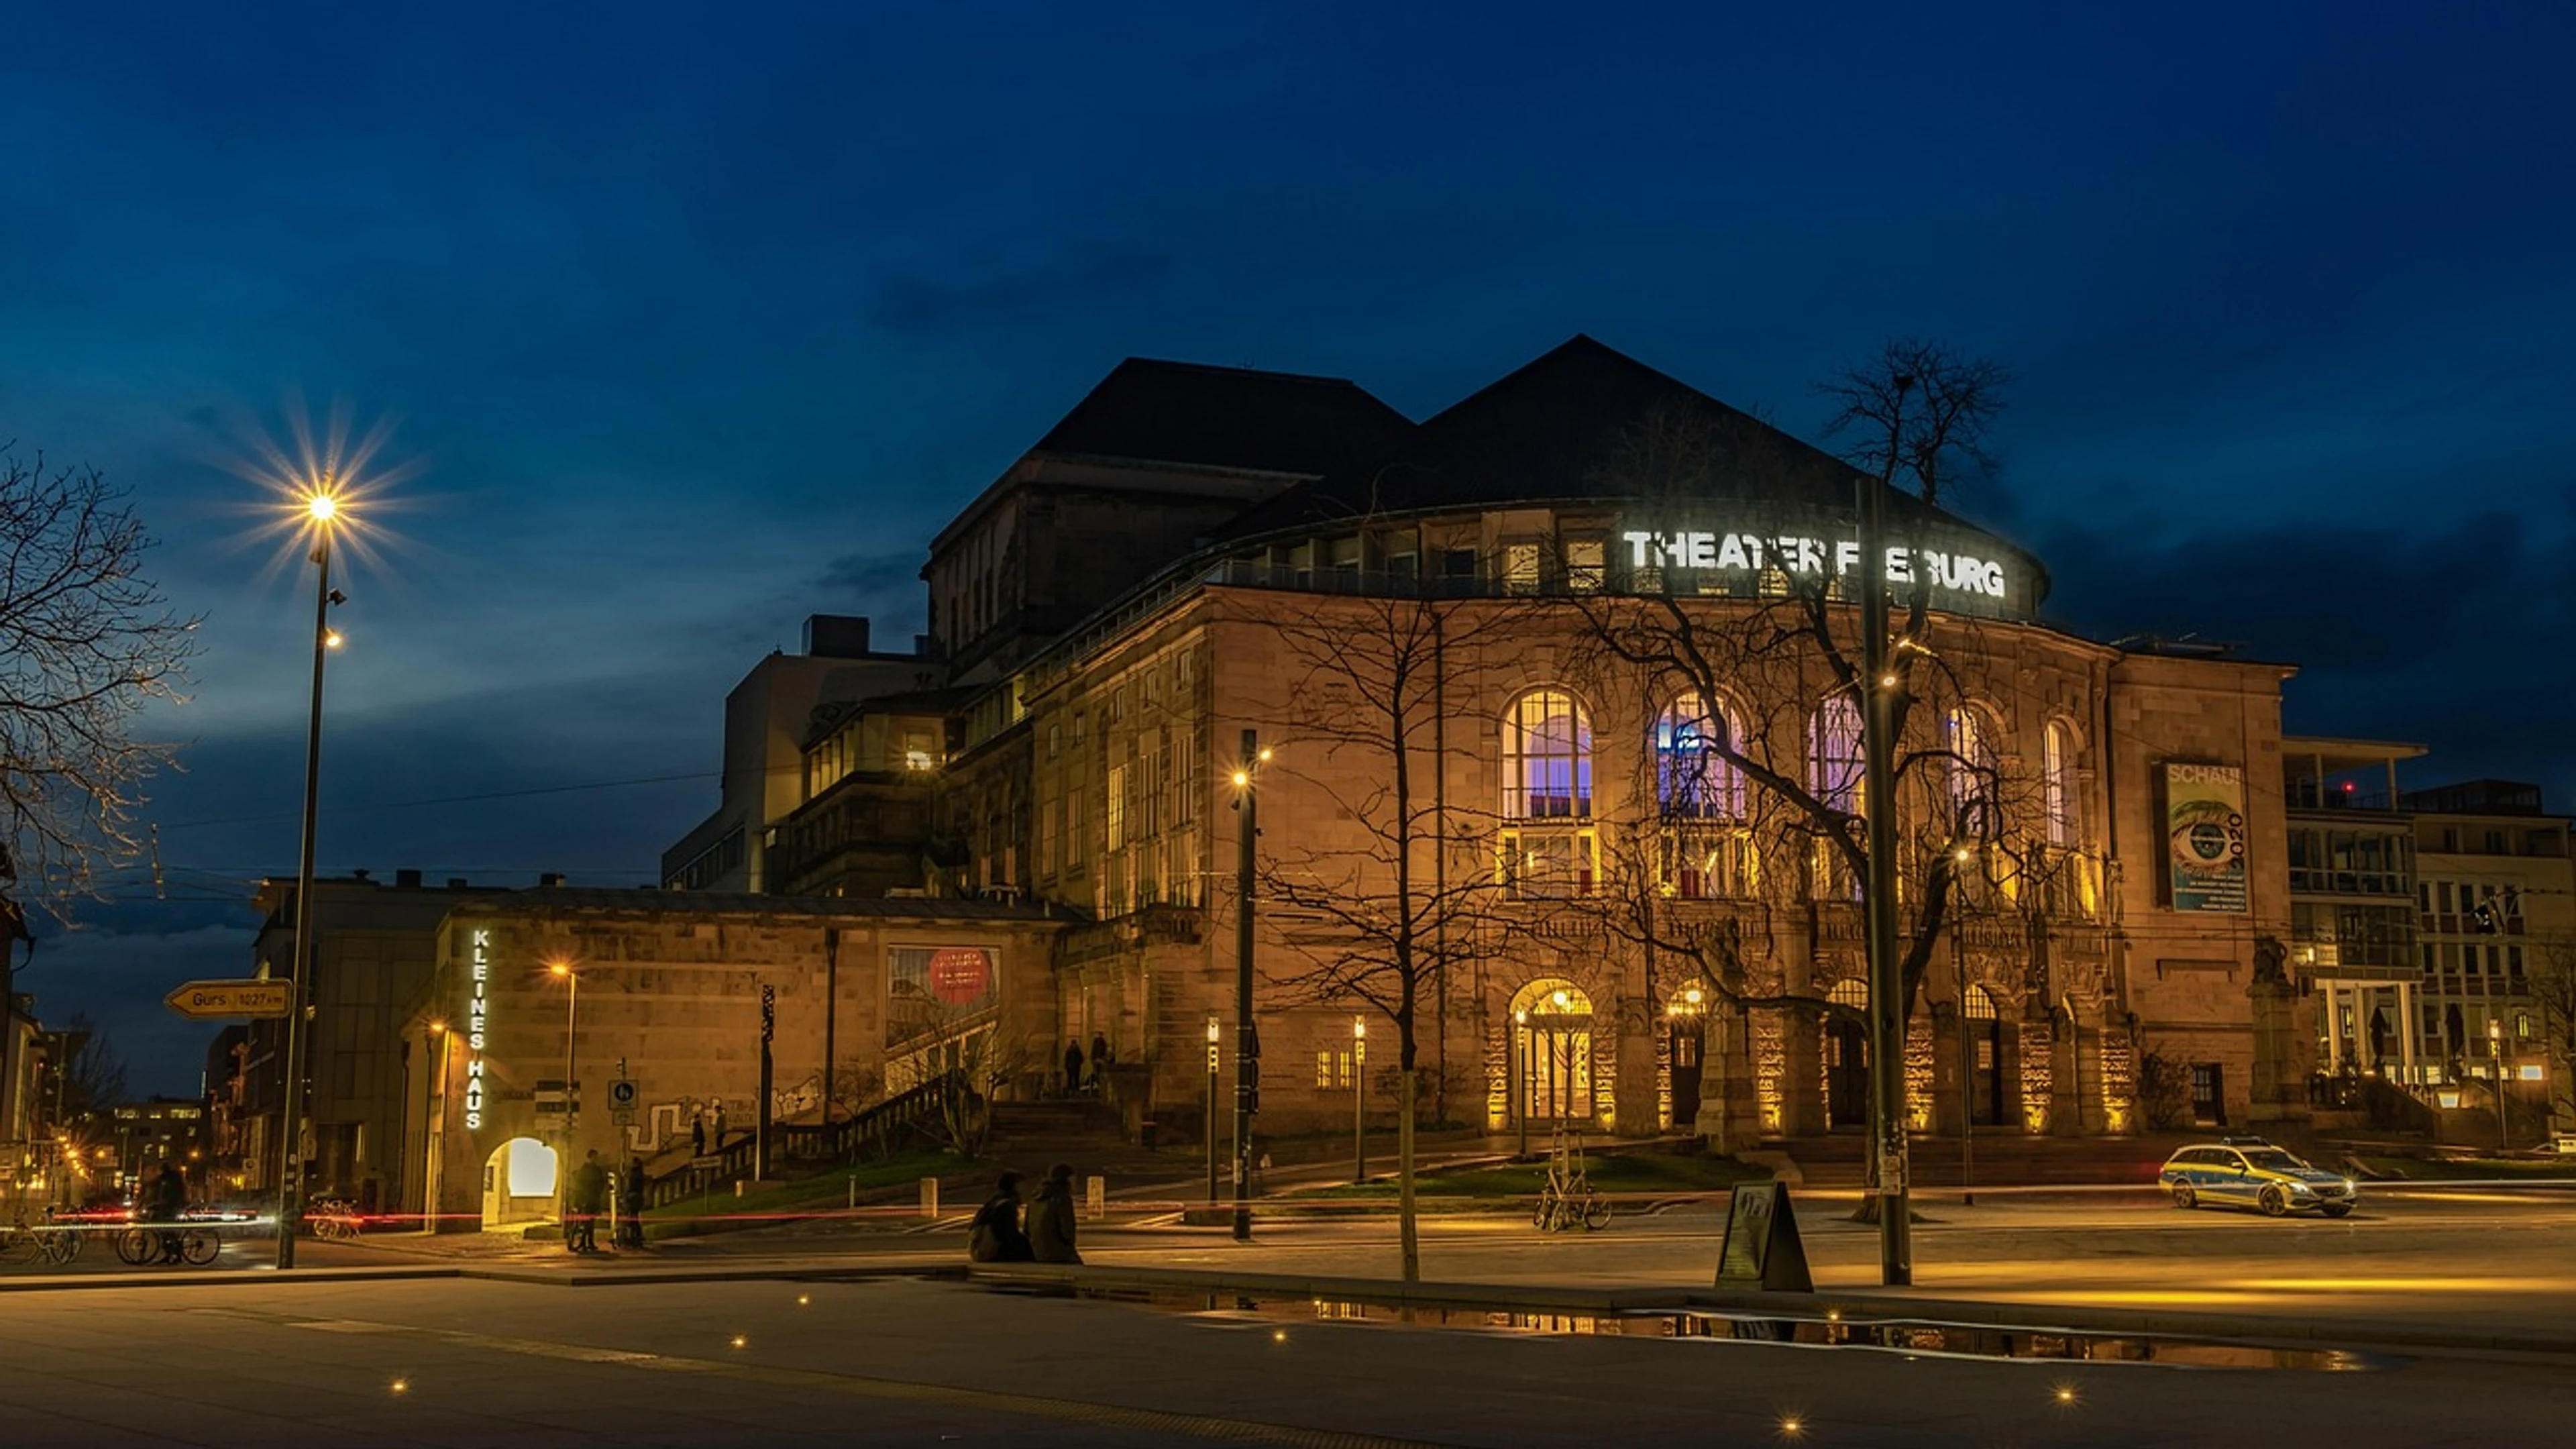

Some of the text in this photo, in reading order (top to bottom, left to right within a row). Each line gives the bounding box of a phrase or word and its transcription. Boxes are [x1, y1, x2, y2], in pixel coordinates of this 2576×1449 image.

[1623, 531, 2005, 598] THEATER FEBURG
[2169, 765, 2241, 785] SCHAU!
[2228, 813, 2245, 869] 2020
[193, 993, 226, 1006] Gurs
[467, 930, 488, 1129] KLEINES HAUS
